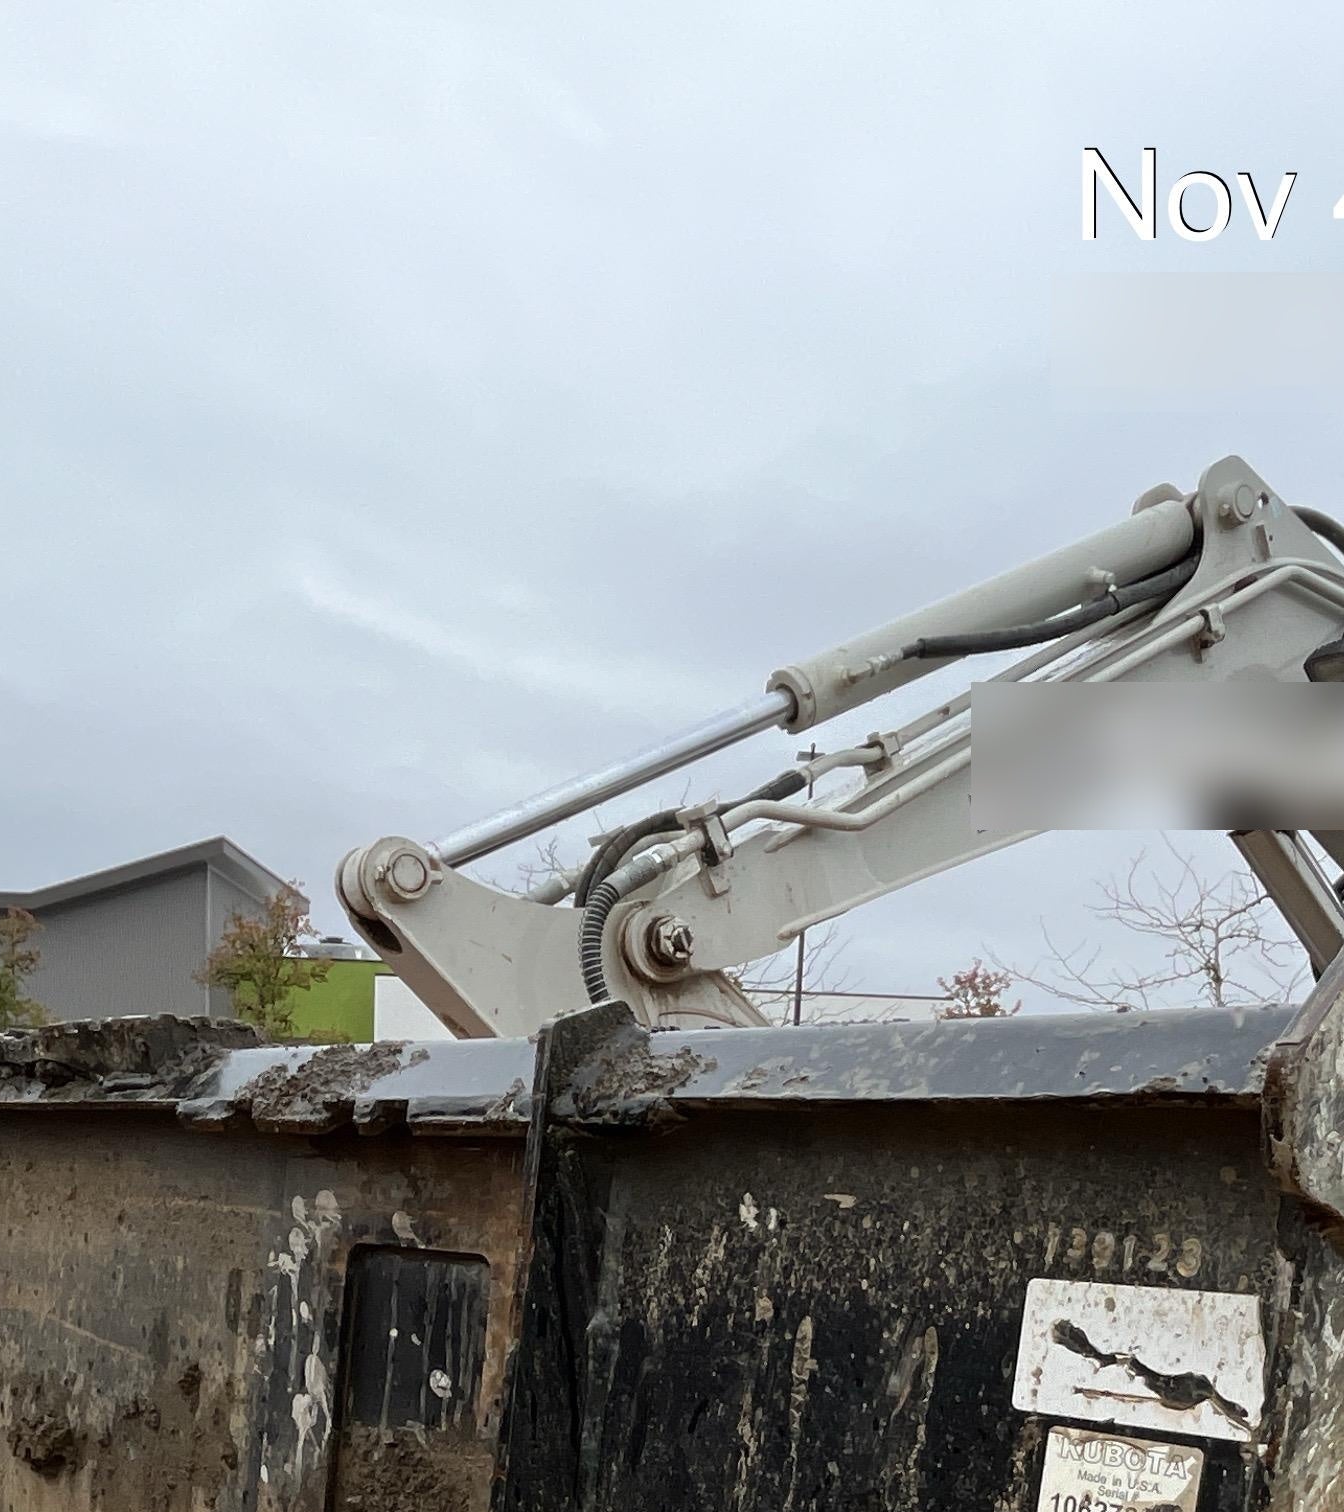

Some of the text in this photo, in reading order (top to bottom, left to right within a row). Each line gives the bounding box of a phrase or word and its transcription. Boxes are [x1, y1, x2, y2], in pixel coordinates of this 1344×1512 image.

[1058, 1437, 1188, 1480] KUBOTA
[1077, 1469, 1107, 1484] Made
[1112, 1476, 1122, 1487] in
[1097, 1485, 1129, 1500] Serial
